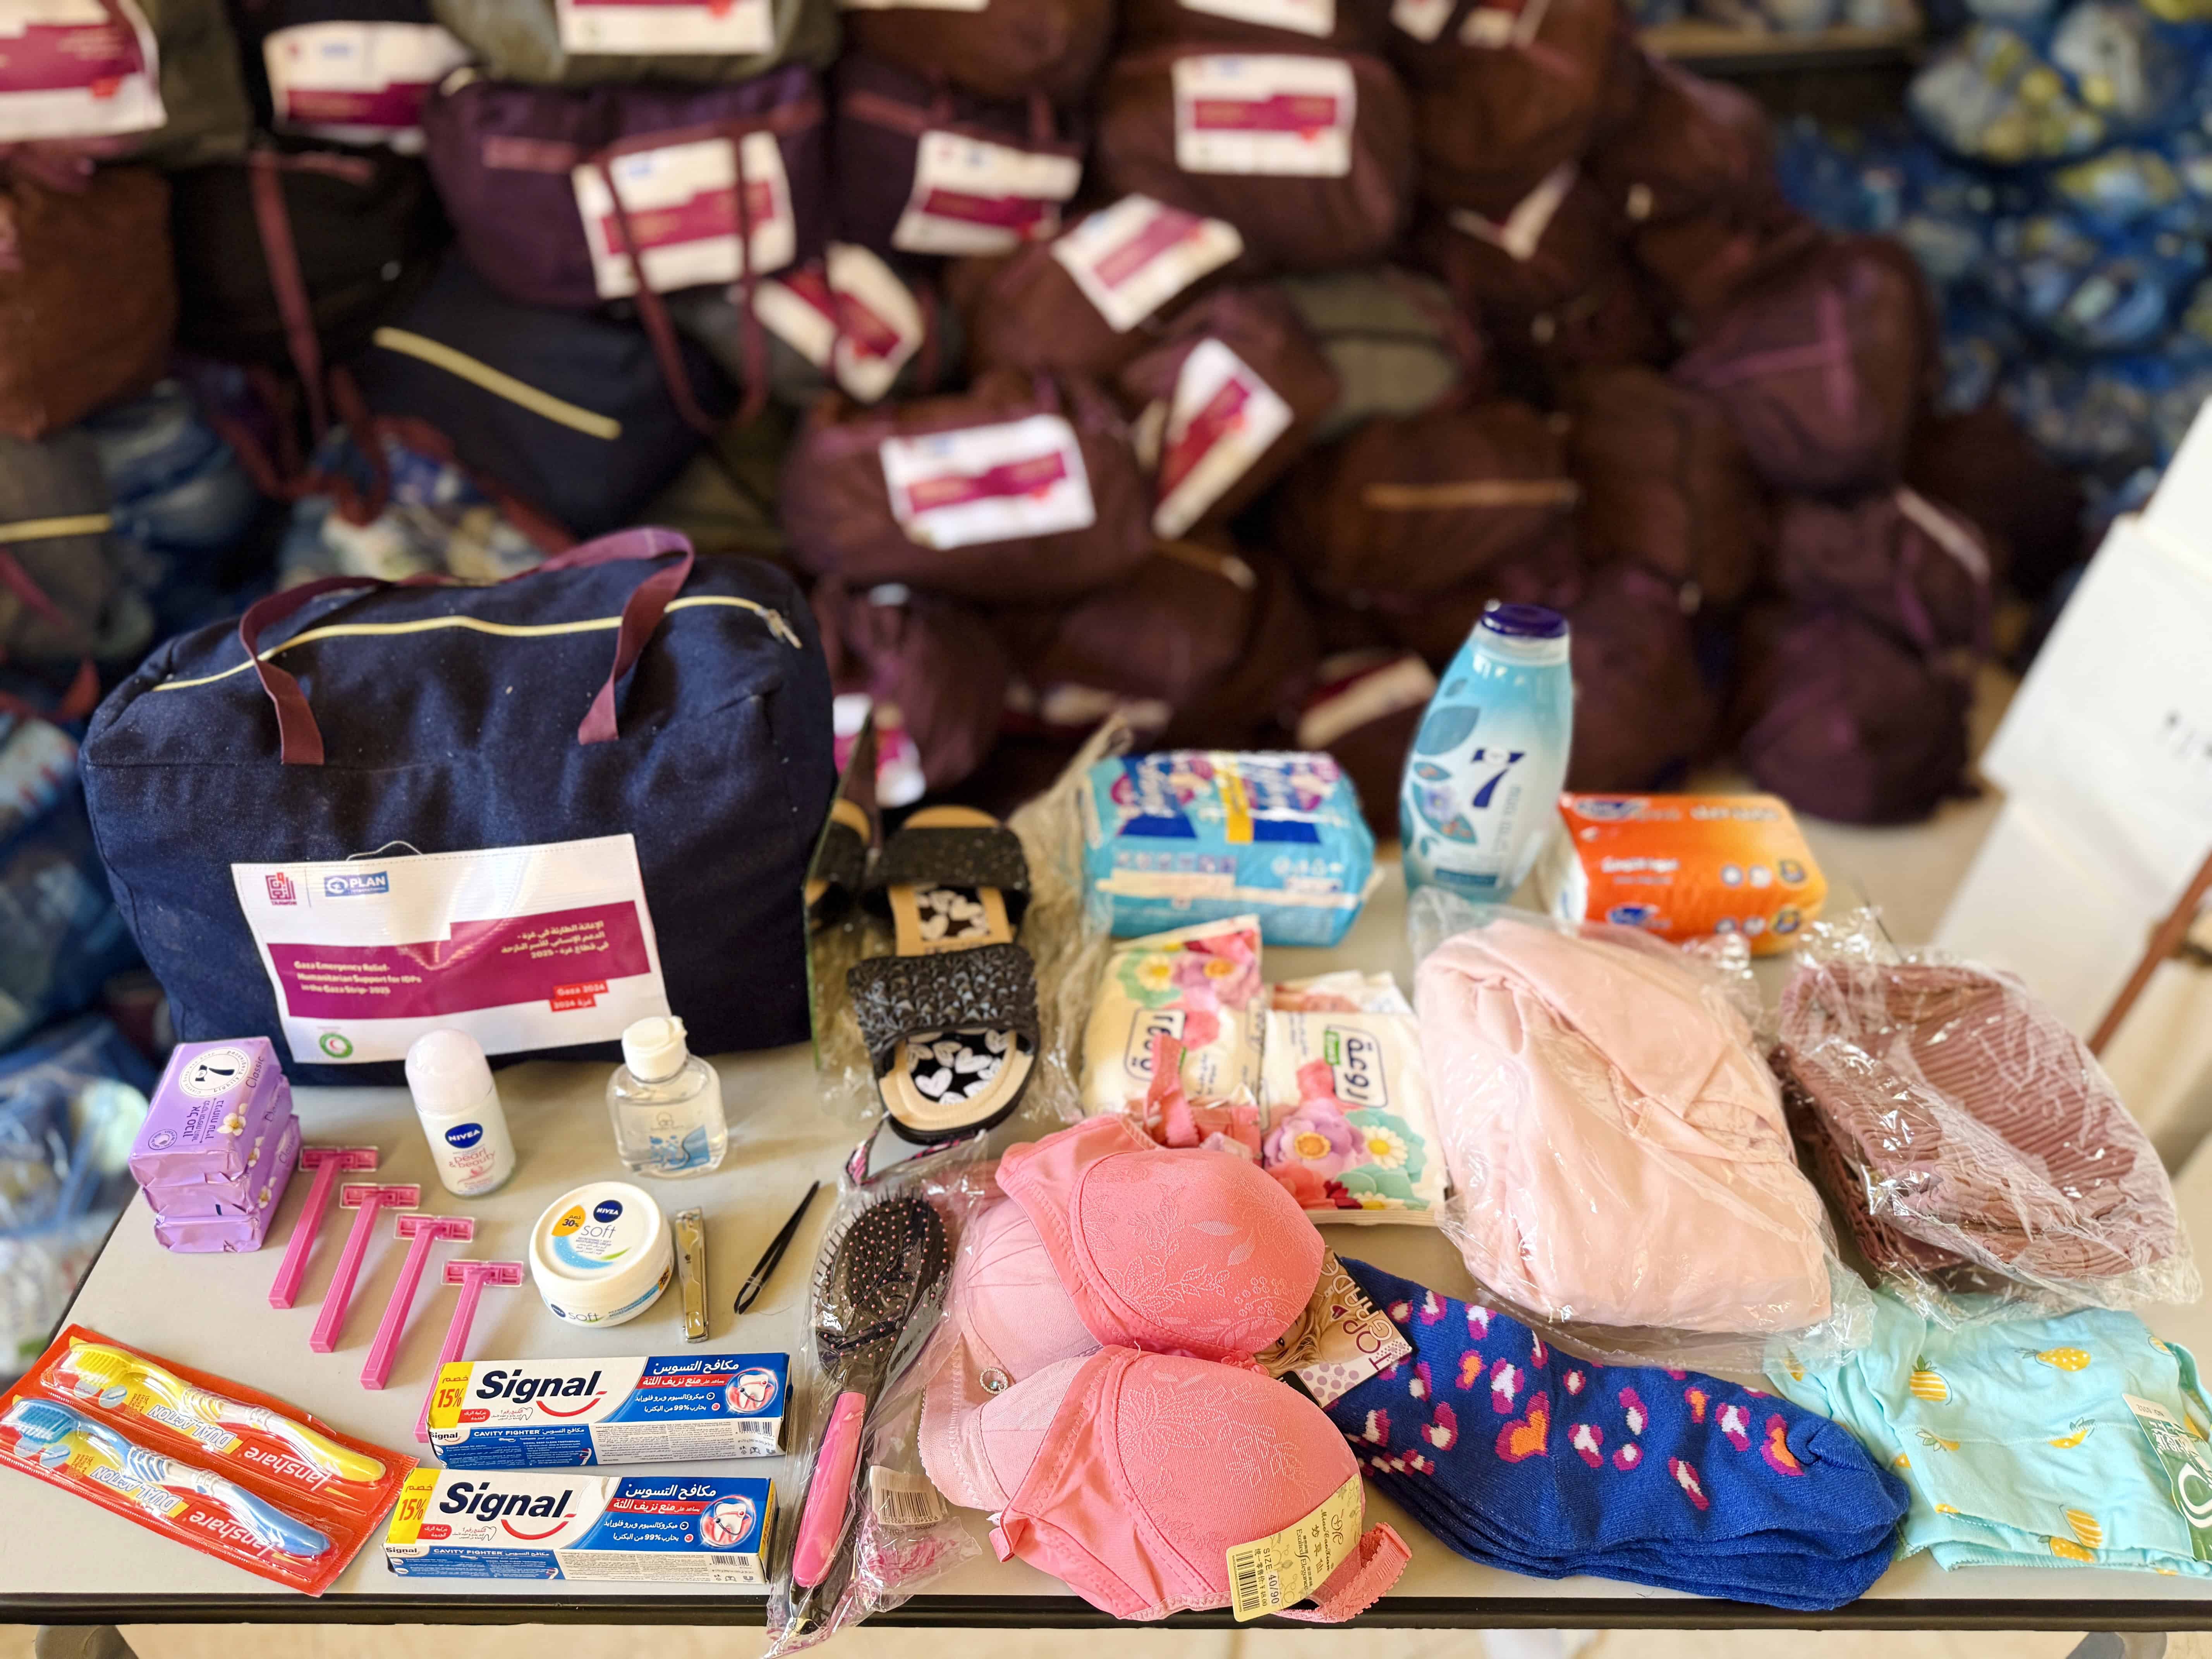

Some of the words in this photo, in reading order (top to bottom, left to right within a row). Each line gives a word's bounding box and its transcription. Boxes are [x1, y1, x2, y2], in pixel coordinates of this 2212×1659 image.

[1471, 748, 1526, 809] 7
[350, 875, 386, 888] PLAN
[294, 960, 316, 969] Gaza
[316, 962, 362, 972] Emergency
[297, 972, 353, 982] Humanitarian
[353, 974, 387, 984] Support
[387, 975, 400, 983] for
[323, 985, 345, 993] Gaza
[557, 987, 581, 996] Gaza
[582, 984, 606, 993] 2024
[195, 1064, 235, 1082] 7
[246, 1056, 264, 1088] Classic
[1344, 1038, 1373, 1100] روعة
[187, 1105, 201, 1118] אל
[210, 1100, 224, 1123] בניחוח
[182, 1119, 196, 1138] סבון
[205, 1123, 216, 1139] עדין
[448, 1129, 481, 1141] NIVEA
[454, 1147, 487, 1163] pearl
[457, 1149, 496, 1168] beauty
[562, 1218, 580, 1227] 30%
[580, 1224, 617, 1239] soft
[1320, 1257, 1393, 1341] GRADE
[568, 1312, 601, 1321] soft
[1342, 1319, 1393, 1371] TOP
[653, 1361, 701, 1375] التسوس
[702, 1360, 740, 1374] مكافح
[441, 1375, 469, 1384] خصم
[476, 1369, 603, 1404] Signal
[642, 1376, 661, 1386] اللثة
[661, 1376, 685, 1387] نزيف
[685, 1378, 701, 1387] منع
[437, 1387, 465, 1408] 15%
[689, 1403, 707, 1412] يحارب
[146, 1404, 197, 1430] ACTION
[192, 1422, 238, 1449] DUAL
[430, 1431, 458, 1440] Signal
[89, 1465, 143, 1491] ACTION
[405, 1484, 433, 1492] خصم
[625, 1484, 677, 1498] التسوس
[678, 1485, 717, 1500] مكافح
[136, 1483, 183, 1513] DUAL
[439, 1482, 574, 1522] Signal
[613, 1499, 633, 1509] اللثة
[398, 1498, 428, 1522] 15%
[634, 1503, 659, 1512] نزيف
[658, 1504, 676, 1514] منع
[1296, 1528, 1305, 1555] Exalted
[1263, 1547, 1273, 1570] SIZE
[1268, 1574, 1280, 1604] 40/90
[1300, 1558, 1309, 1590] Elegance
